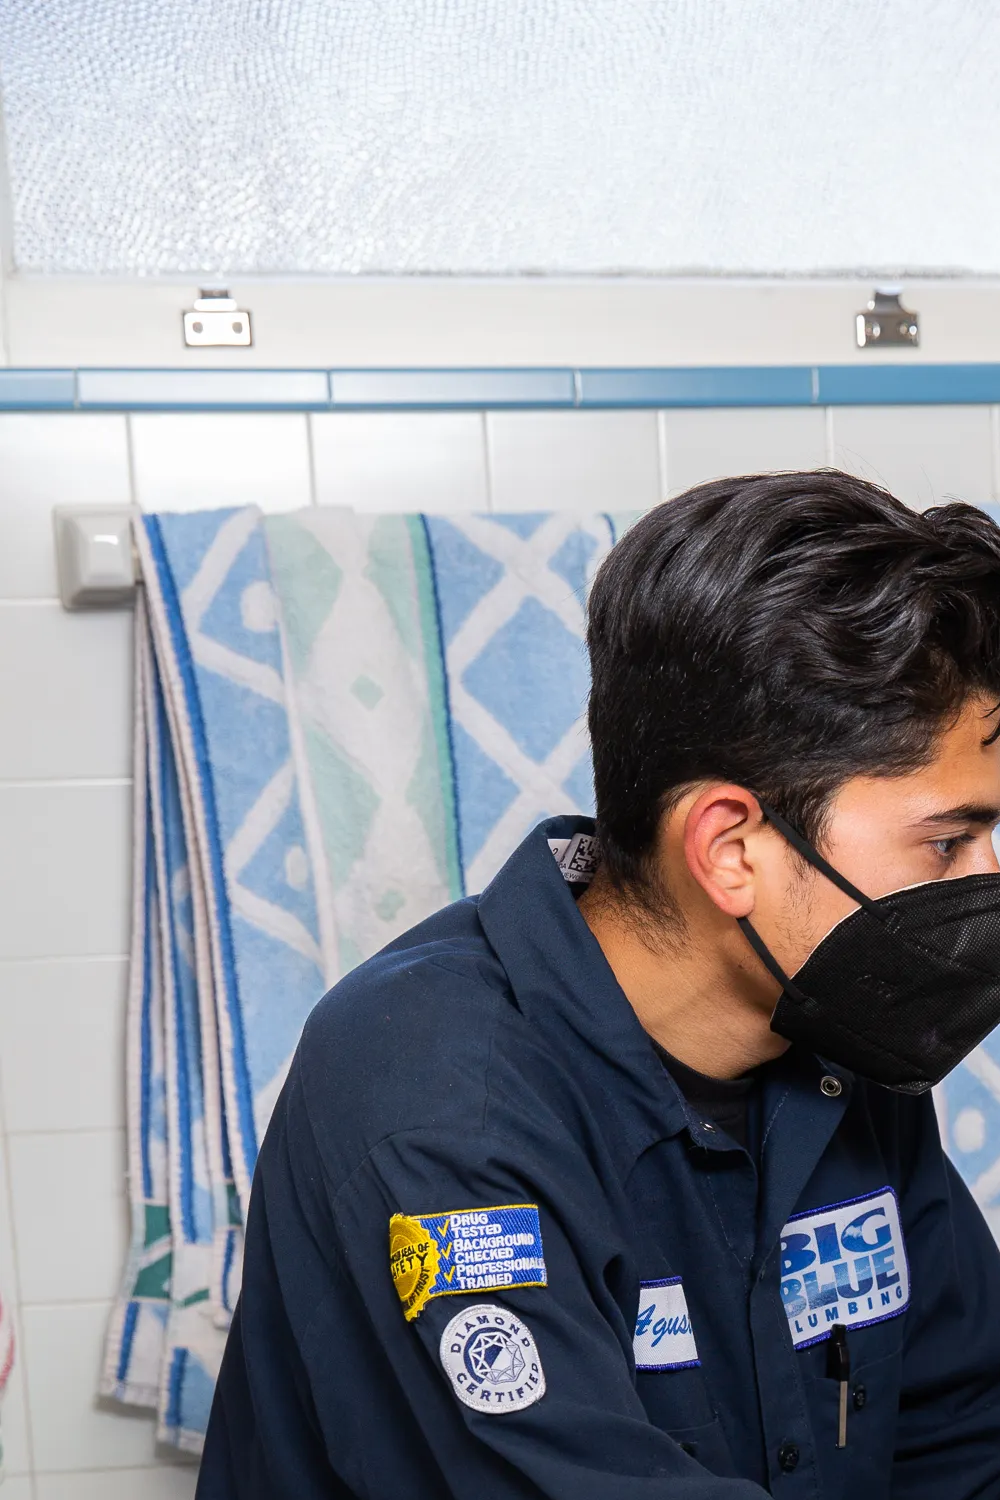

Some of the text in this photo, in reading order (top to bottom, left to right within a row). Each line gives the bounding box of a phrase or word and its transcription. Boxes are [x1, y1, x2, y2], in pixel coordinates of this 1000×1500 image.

[450, 1213, 488, 1227] DRUG
[451, 1224, 502, 1238] TESTED
[418, 1242, 430, 1252] OF
[453, 1233, 534, 1252] BACKGROUND
[455, 1247, 514, 1264] CHECKED
[780, 1207, 893, 1278] BIG
[393, 1252, 428, 1279] AFETY
[414, 1267, 430, 1296] TRUST
[457, 1273, 512, 1289] TRAINED
[780, 1246, 900, 1319] BLUE
[795, 1285, 902, 1333] LUMBING
[451, 1314, 530, 1354] DIAMOND
[636, 1304, 691, 1347] Agus
[457, 1363, 538, 1402] CERTIFIED
